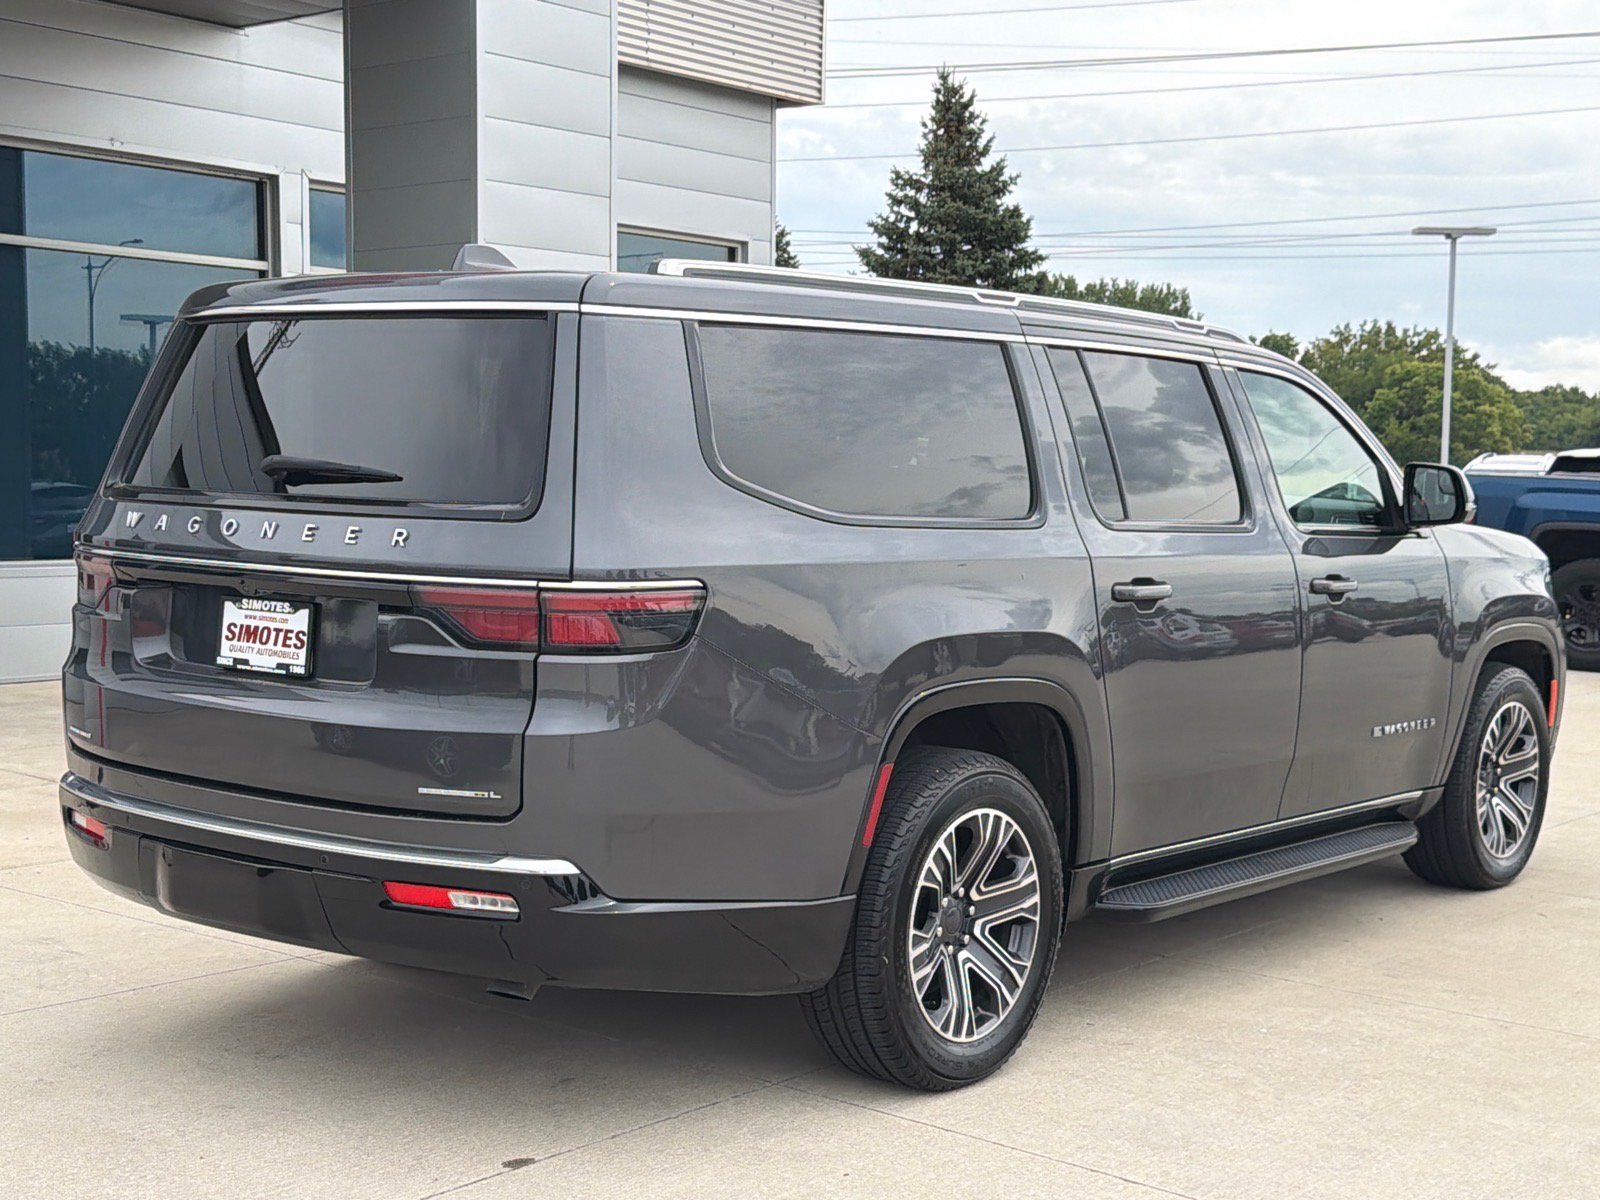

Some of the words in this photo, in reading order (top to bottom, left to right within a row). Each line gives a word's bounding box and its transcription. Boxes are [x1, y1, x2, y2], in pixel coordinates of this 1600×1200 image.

[126, 511, 408, 547] WAGONEER
[241, 598, 291, 613] SIMOTES
[225, 622, 307, 650] SIMOTES
[229, 644, 255, 655] QUALITY
[256, 647, 300, 660] AUTOMOBILES
